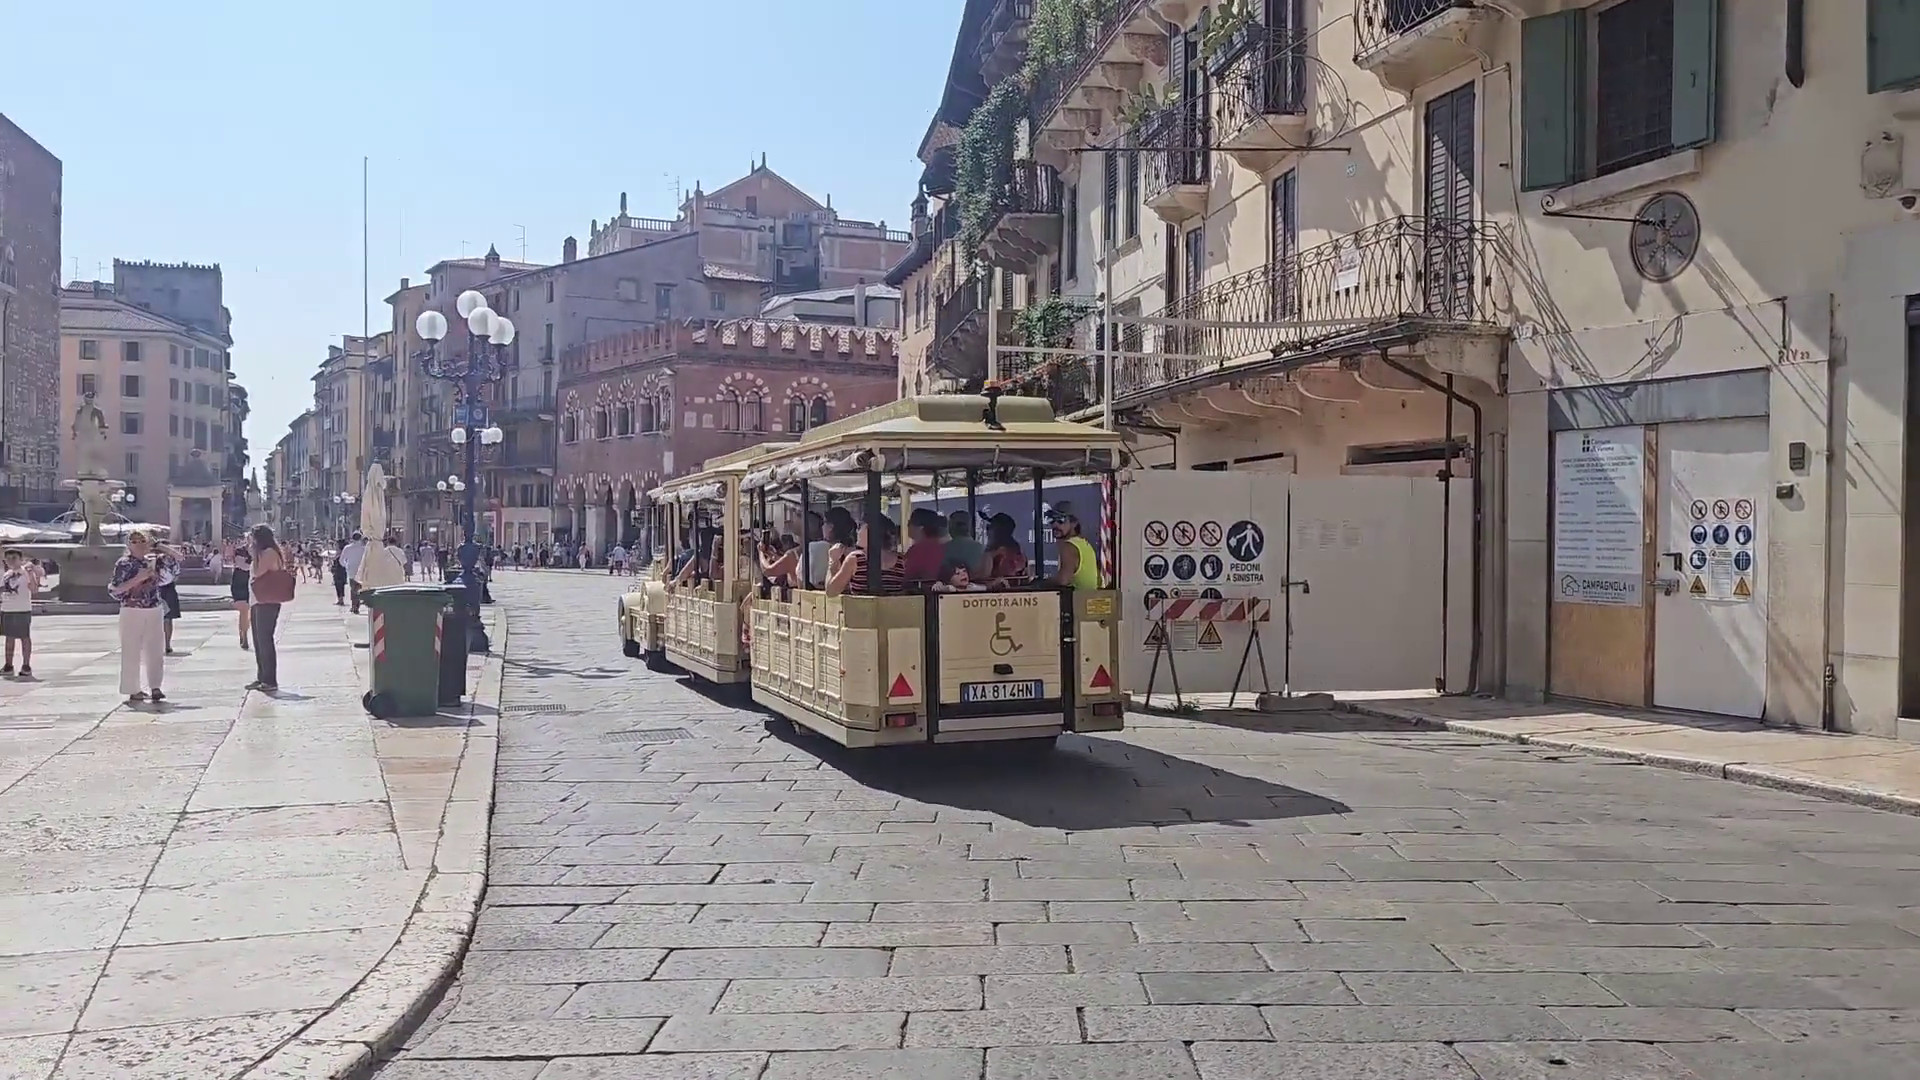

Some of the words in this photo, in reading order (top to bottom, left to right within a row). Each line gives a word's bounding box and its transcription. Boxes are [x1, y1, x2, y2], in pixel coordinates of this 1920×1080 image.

[1230, 563, 1261, 572] PEDONI
[1226, 573, 1231, 582] A
[1232, 573, 1264, 582] SINISTRA
[1582, 579, 1627, 592] CAMPAGNOLA
[963, 597, 1038, 608] DOTTOTRAINS
[972, 685, 987, 700] XA
[992, 684, 1033, 699] 814HN
